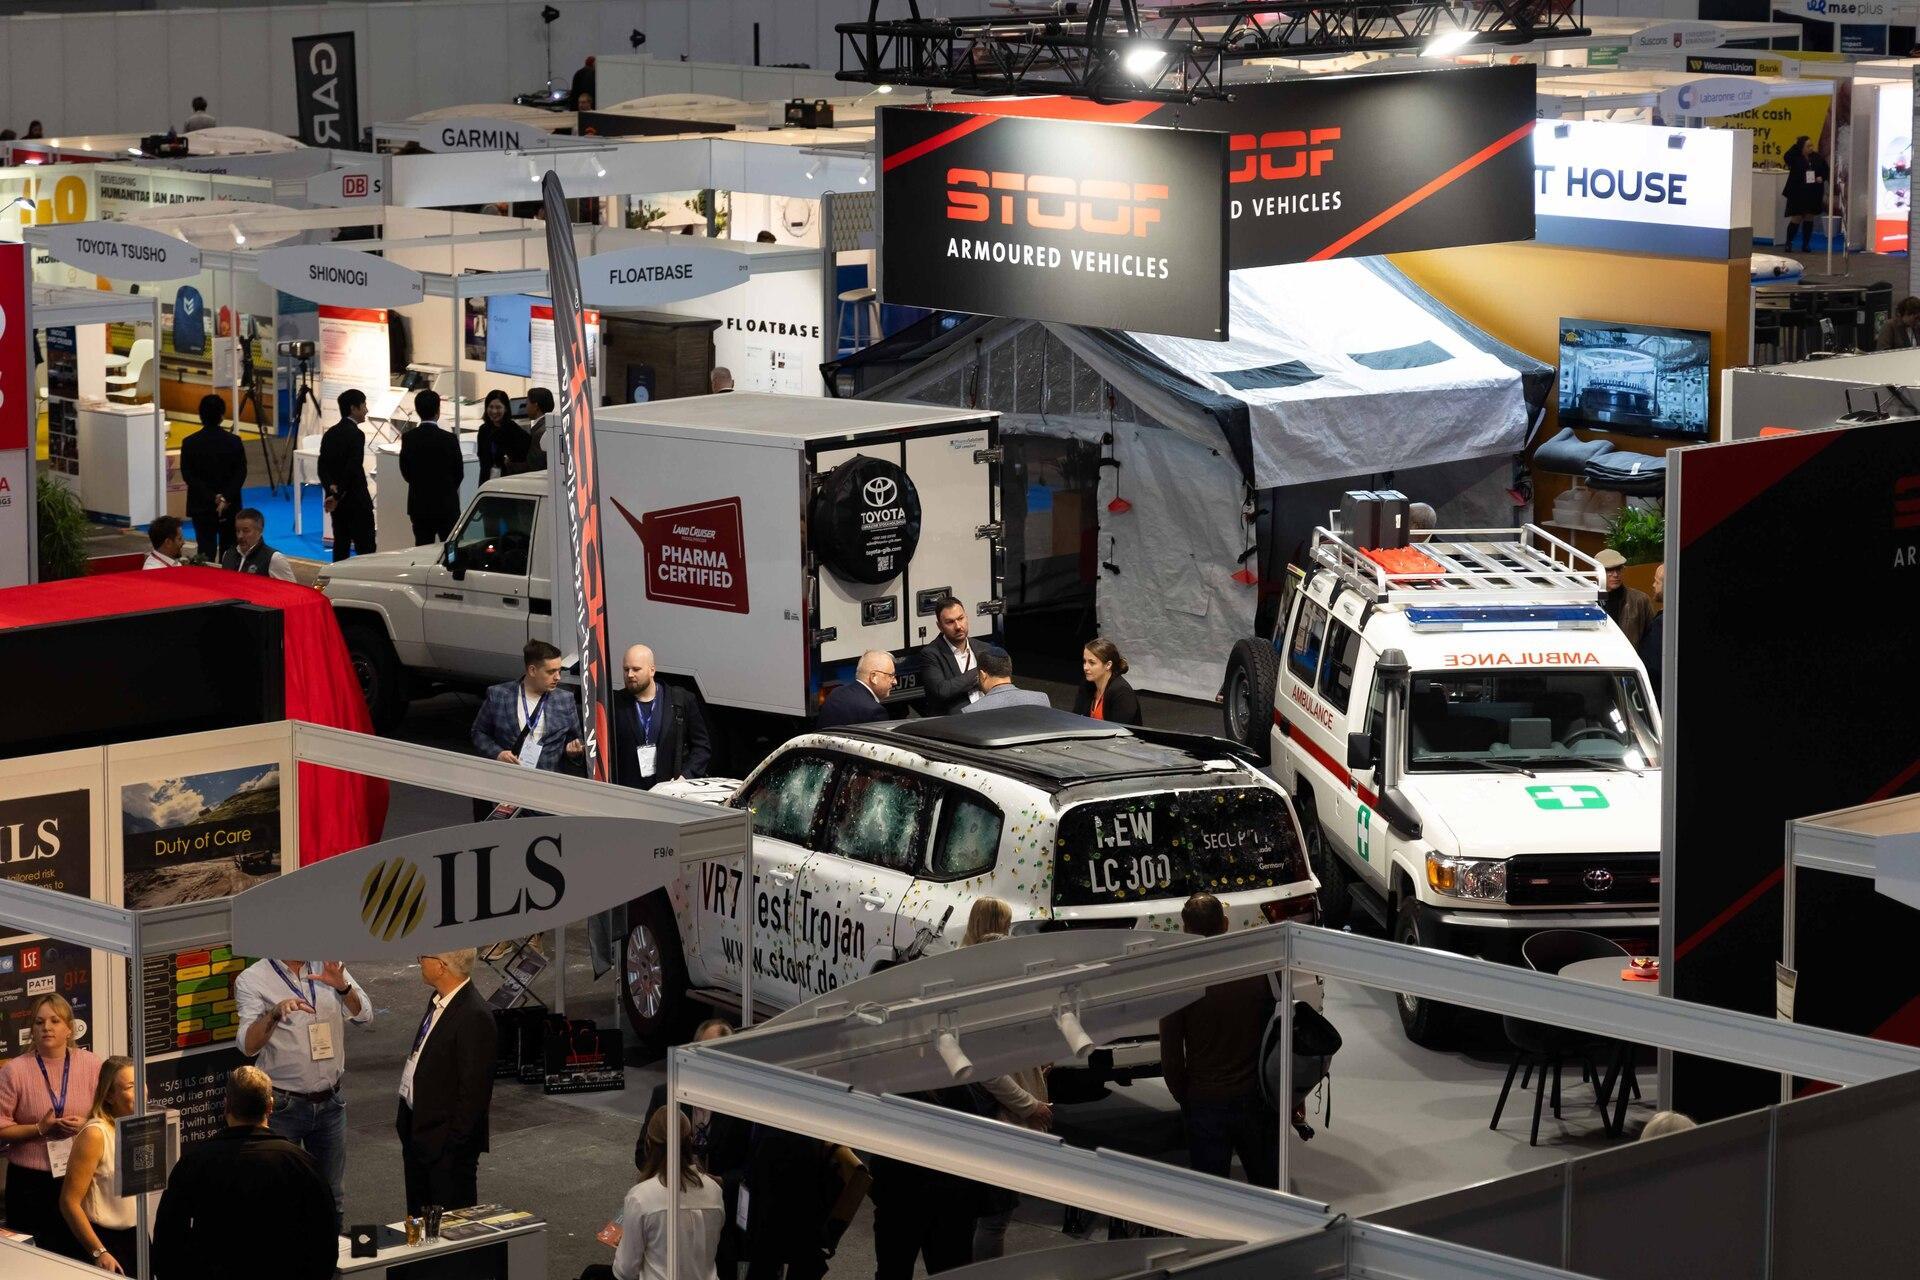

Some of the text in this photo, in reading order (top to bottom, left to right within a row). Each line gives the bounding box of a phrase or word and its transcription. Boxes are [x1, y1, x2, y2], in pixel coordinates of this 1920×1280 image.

[1828, 1, 1884, 16] m&e plus
[1704, 60, 1779, 73] Western Union Bank
[1762, 108, 1792, 121] cash
[441, 127, 519, 150] GARMIN
[1762, 142, 1782, 155] it's
[101, 174, 137, 187] DEVELOPING
[345, 178, 365, 194] DB
[1567, 166, 1688, 206] HOUSE
[947, 167, 1169, 238] STOOF
[1229, 189, 1343, 220] D VEHICLES
[76, 238, 118, 257] TOYOTA
[121, 243, 167, 264] TSUSHO
[946, 237, 1169, 280] ARMOURED VEHICLES
[308, 264, 368, 287] SHIONOGI
[609, 263, 694, 285] FLOATBASE
[726, 317, 820, 339] FLOATBASE
[860, 507, 906, 524] TOYOTA
[689, 525, 716, 539] CRUISER
[661, 544, 729, 570] PHARMA
[657, 563, 733, 589] CERTIFIED
[1291, 686, 1334, 730] AMBULANCE
[155, 827, 252, 857] Duty of Care
[42, 868, 56, 878] risk
[433, 832, 566, 929] ILS
[1089, 853, 1172, 894] LC 300
[702, 862, 866, 966] VR7 Test Trojan
[23, 951, 37, 969] LSE
[28, 978, 54, 989] PATH
[184, 1077, 196, 1087] ILS
[199, 1074, 214, 1084] are
[188, 1089, 203, 1100] the
[186, 1115, 206, 1129] with
[207, 1113, 216, 1124] in
[191, 1129, 206, 1140] this
